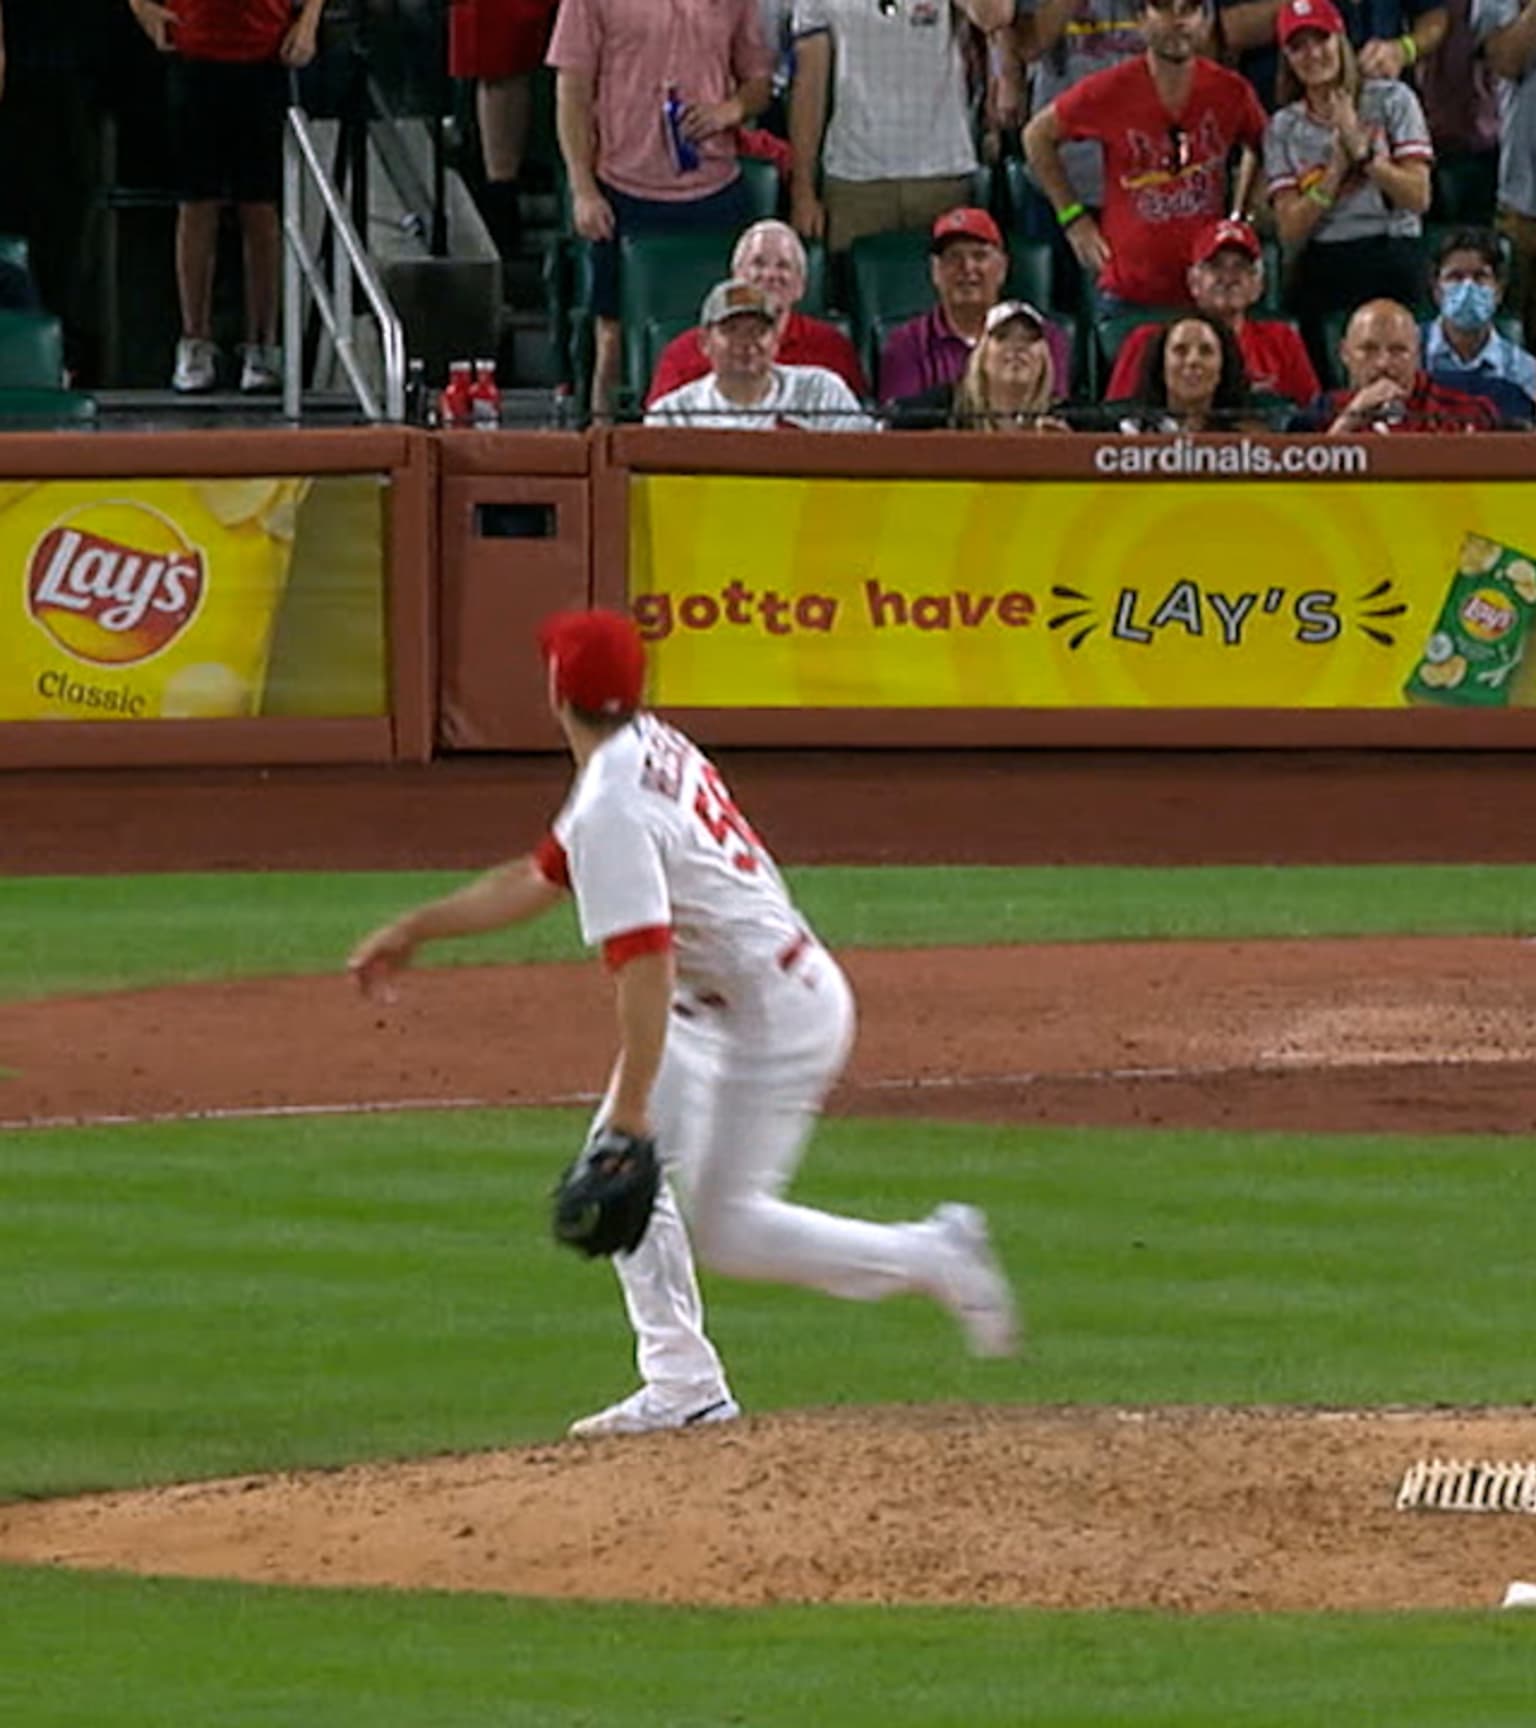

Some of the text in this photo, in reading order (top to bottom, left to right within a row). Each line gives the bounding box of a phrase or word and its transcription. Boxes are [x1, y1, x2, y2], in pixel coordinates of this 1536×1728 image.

[1094, 437, 1369, 473] cardinals.com
[34, 529, 198, 633] Lay's
[633, 578, 1343, 647] gotta have LAY'S
[36, 670, 147, 718] Classic
